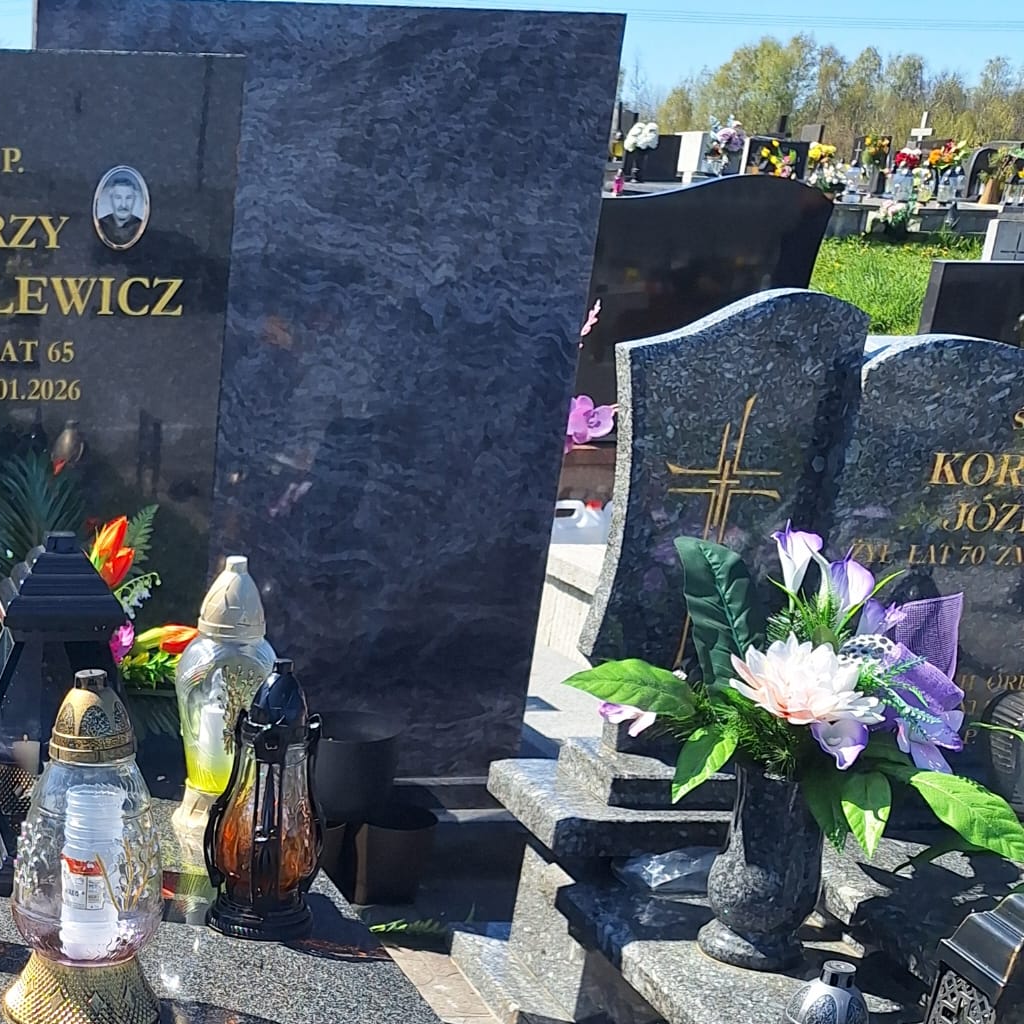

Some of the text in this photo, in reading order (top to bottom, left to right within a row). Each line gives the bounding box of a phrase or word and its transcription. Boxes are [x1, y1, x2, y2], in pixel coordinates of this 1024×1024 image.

[47, 340, 75, 364] 65
[942, 493, 1024, 533] JÓZ
[908, 543, 953, 565] LAT
[958, 545, 986, 566] 70
